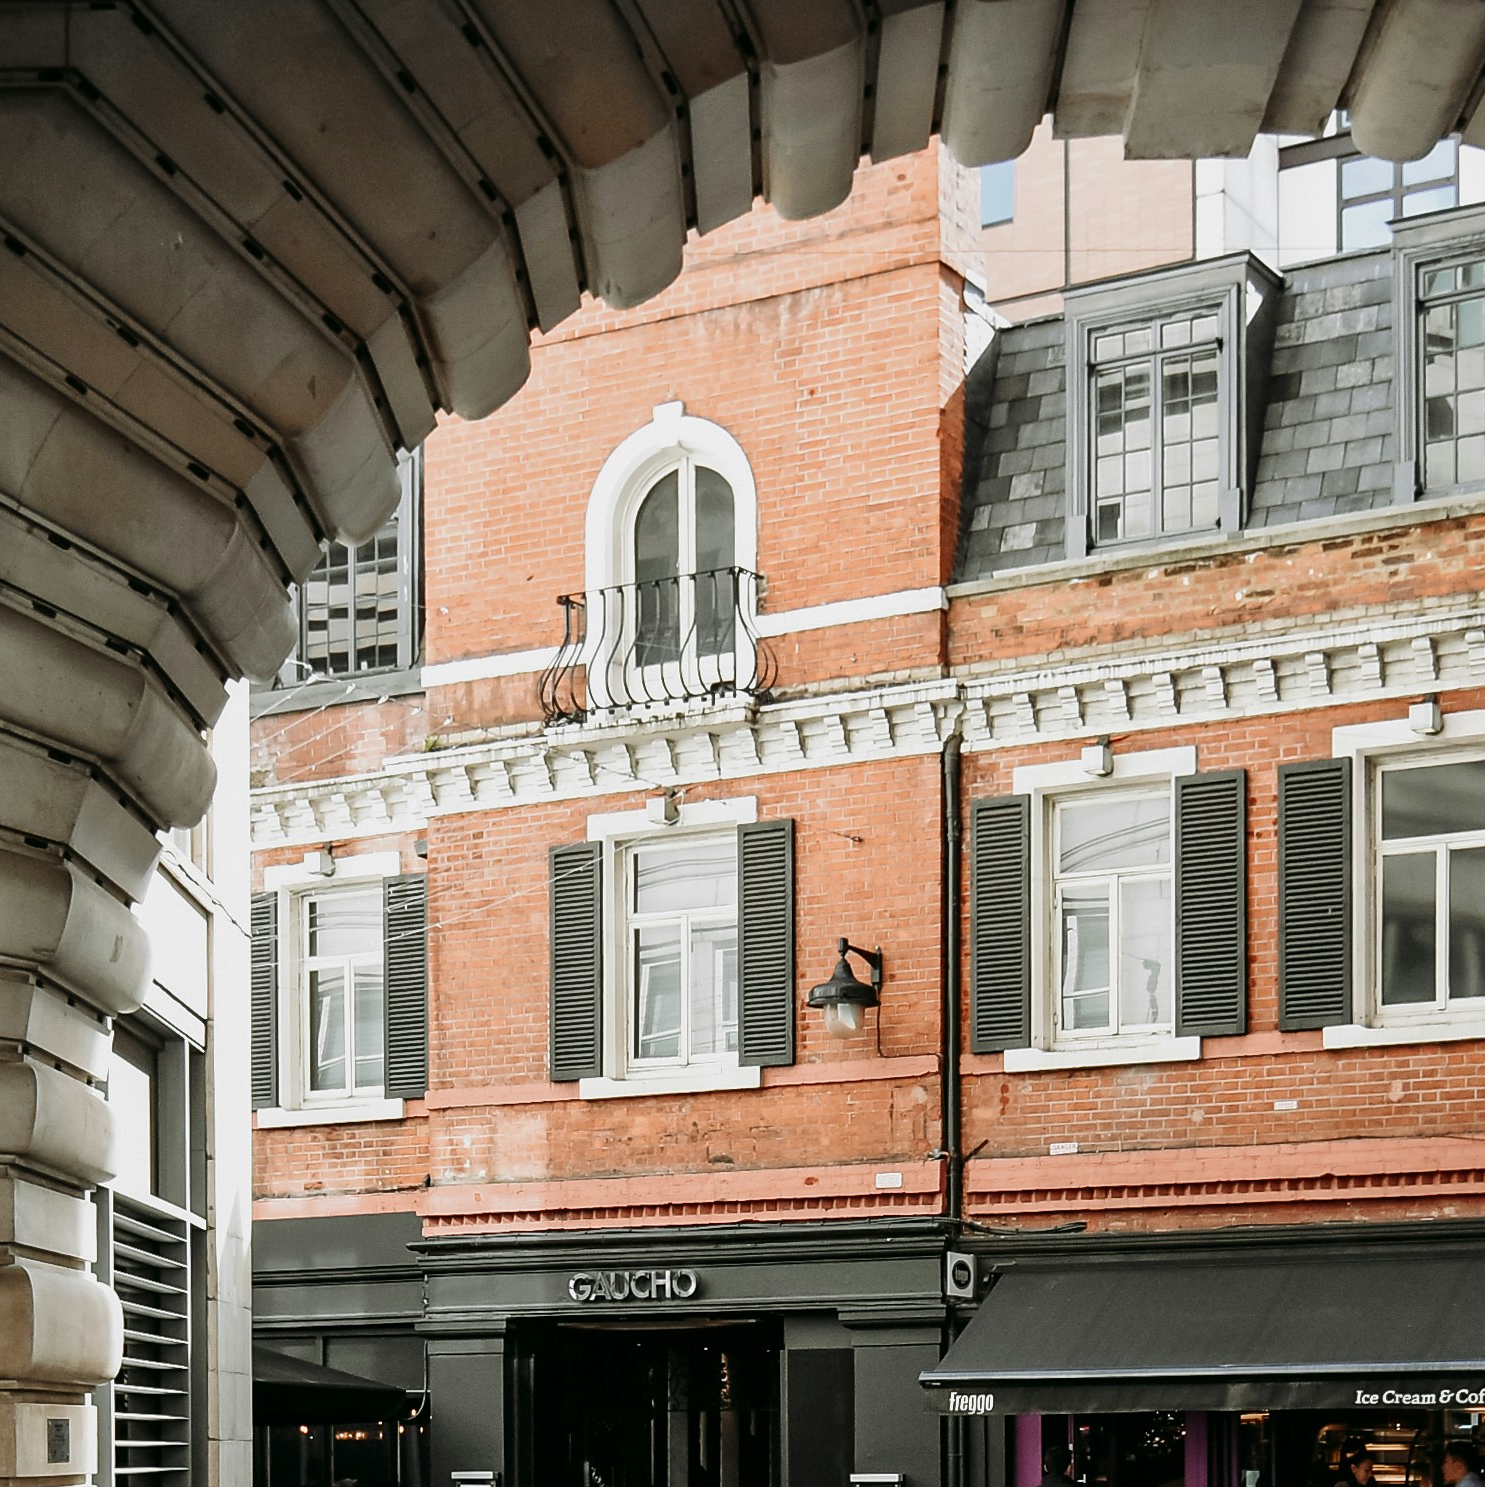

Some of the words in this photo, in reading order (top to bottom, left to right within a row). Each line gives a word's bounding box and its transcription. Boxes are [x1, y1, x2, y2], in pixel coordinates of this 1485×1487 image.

[568, 1268, 698, 1301] GAUCHO
[1354, 1390, 1379, 1405] Ice
[1382, 1390, 1437, 1405] Cream
[1438, 1389, 1454, 1404] &
